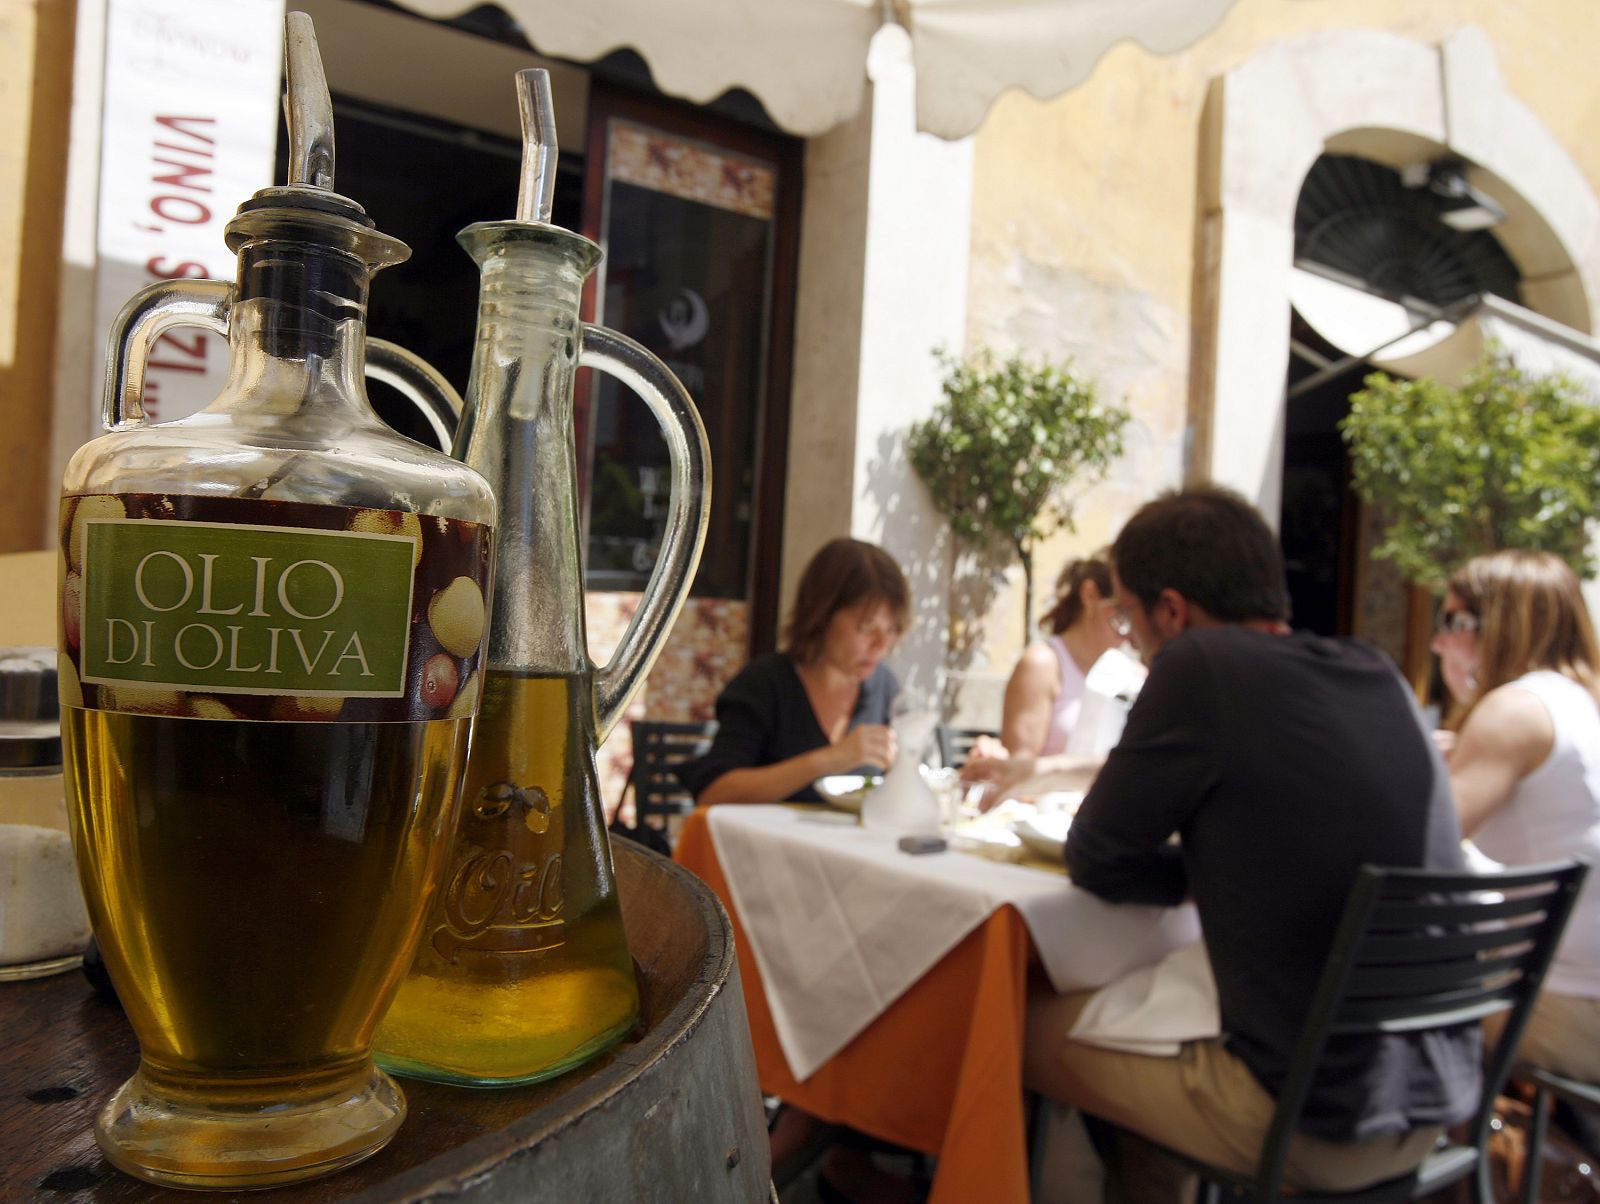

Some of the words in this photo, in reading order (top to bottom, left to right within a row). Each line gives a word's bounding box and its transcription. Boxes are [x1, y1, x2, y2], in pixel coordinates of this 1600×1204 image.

[133, 114, 216, 233] VINO,
[135, 550, 344, 620] OLIO
[105, 618, 156, 667] DI
[174, 623, 374, 676] OLIVA
[445, 850, 564, 941] Oil
